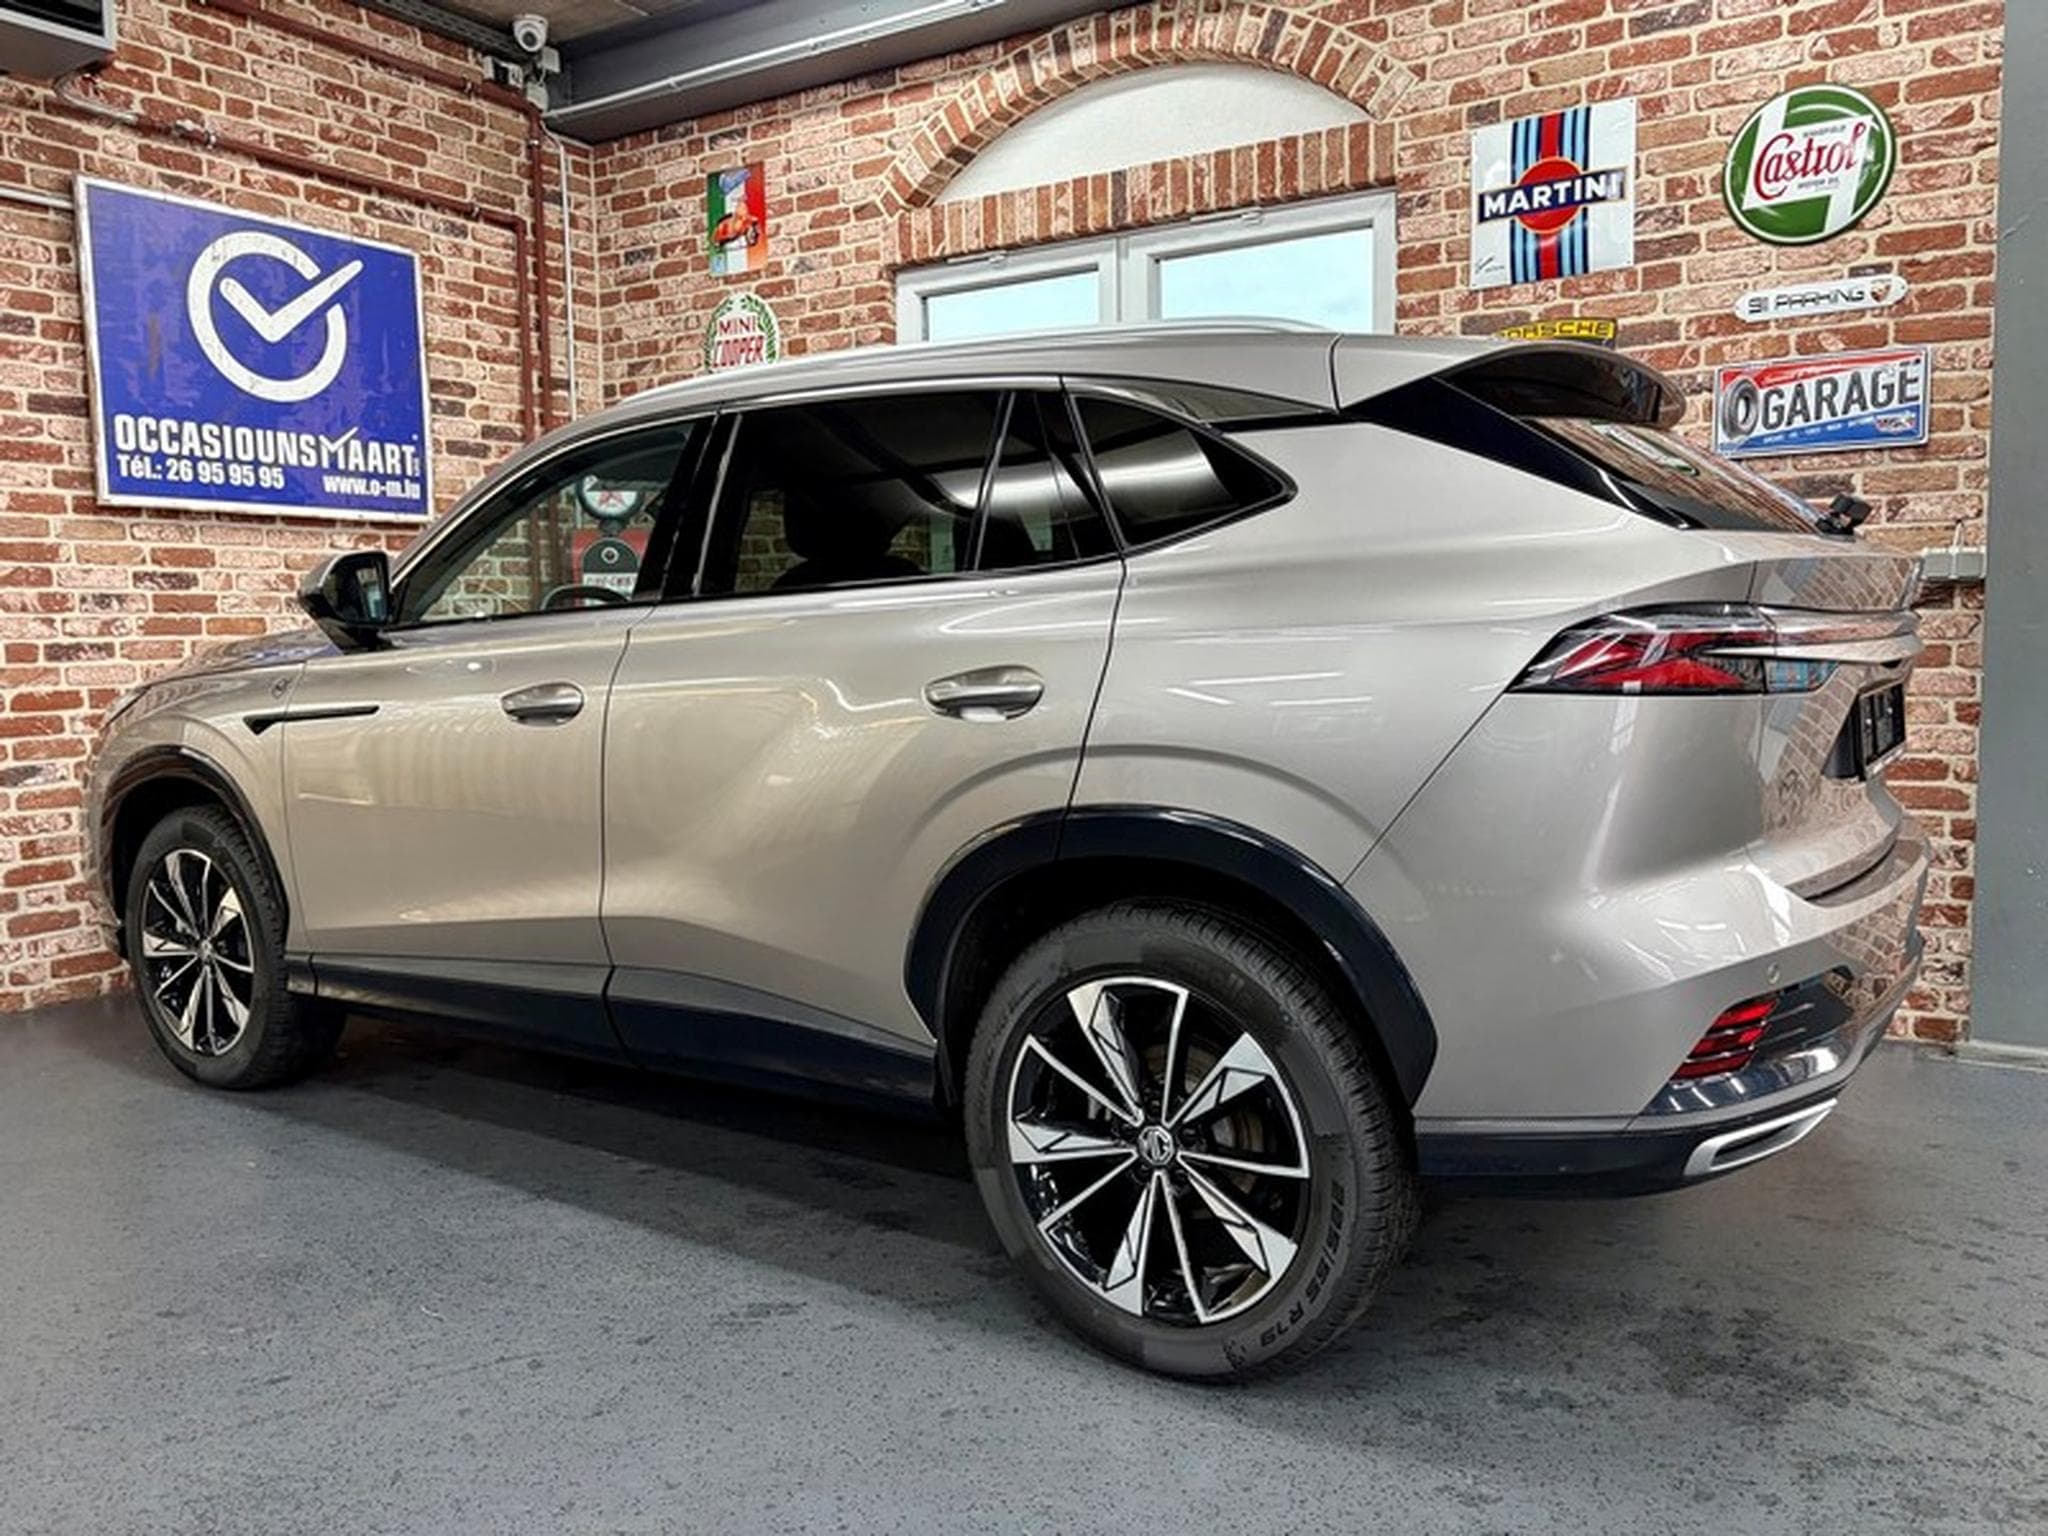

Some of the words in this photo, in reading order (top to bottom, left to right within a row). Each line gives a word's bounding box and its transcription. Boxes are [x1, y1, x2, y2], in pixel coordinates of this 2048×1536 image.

[1753, 122, 1866, 201] Castrol
[1483, 172, 1619, 219] MARTINI
[1774, 289, 1865, 311] PARKING
[719, 315, 756, 336] MINI
[712, 335, 764, 368] COOPER
[1761, 358, 1920, 431] GARAGE
[165, 457, 194, 483] 26
[197, 459, 226, 486] 95
[229, 462, 256, 488] 95
[258, 465, 286, 490] 95
[322, 475, 421, 500] www.o-m.lu
